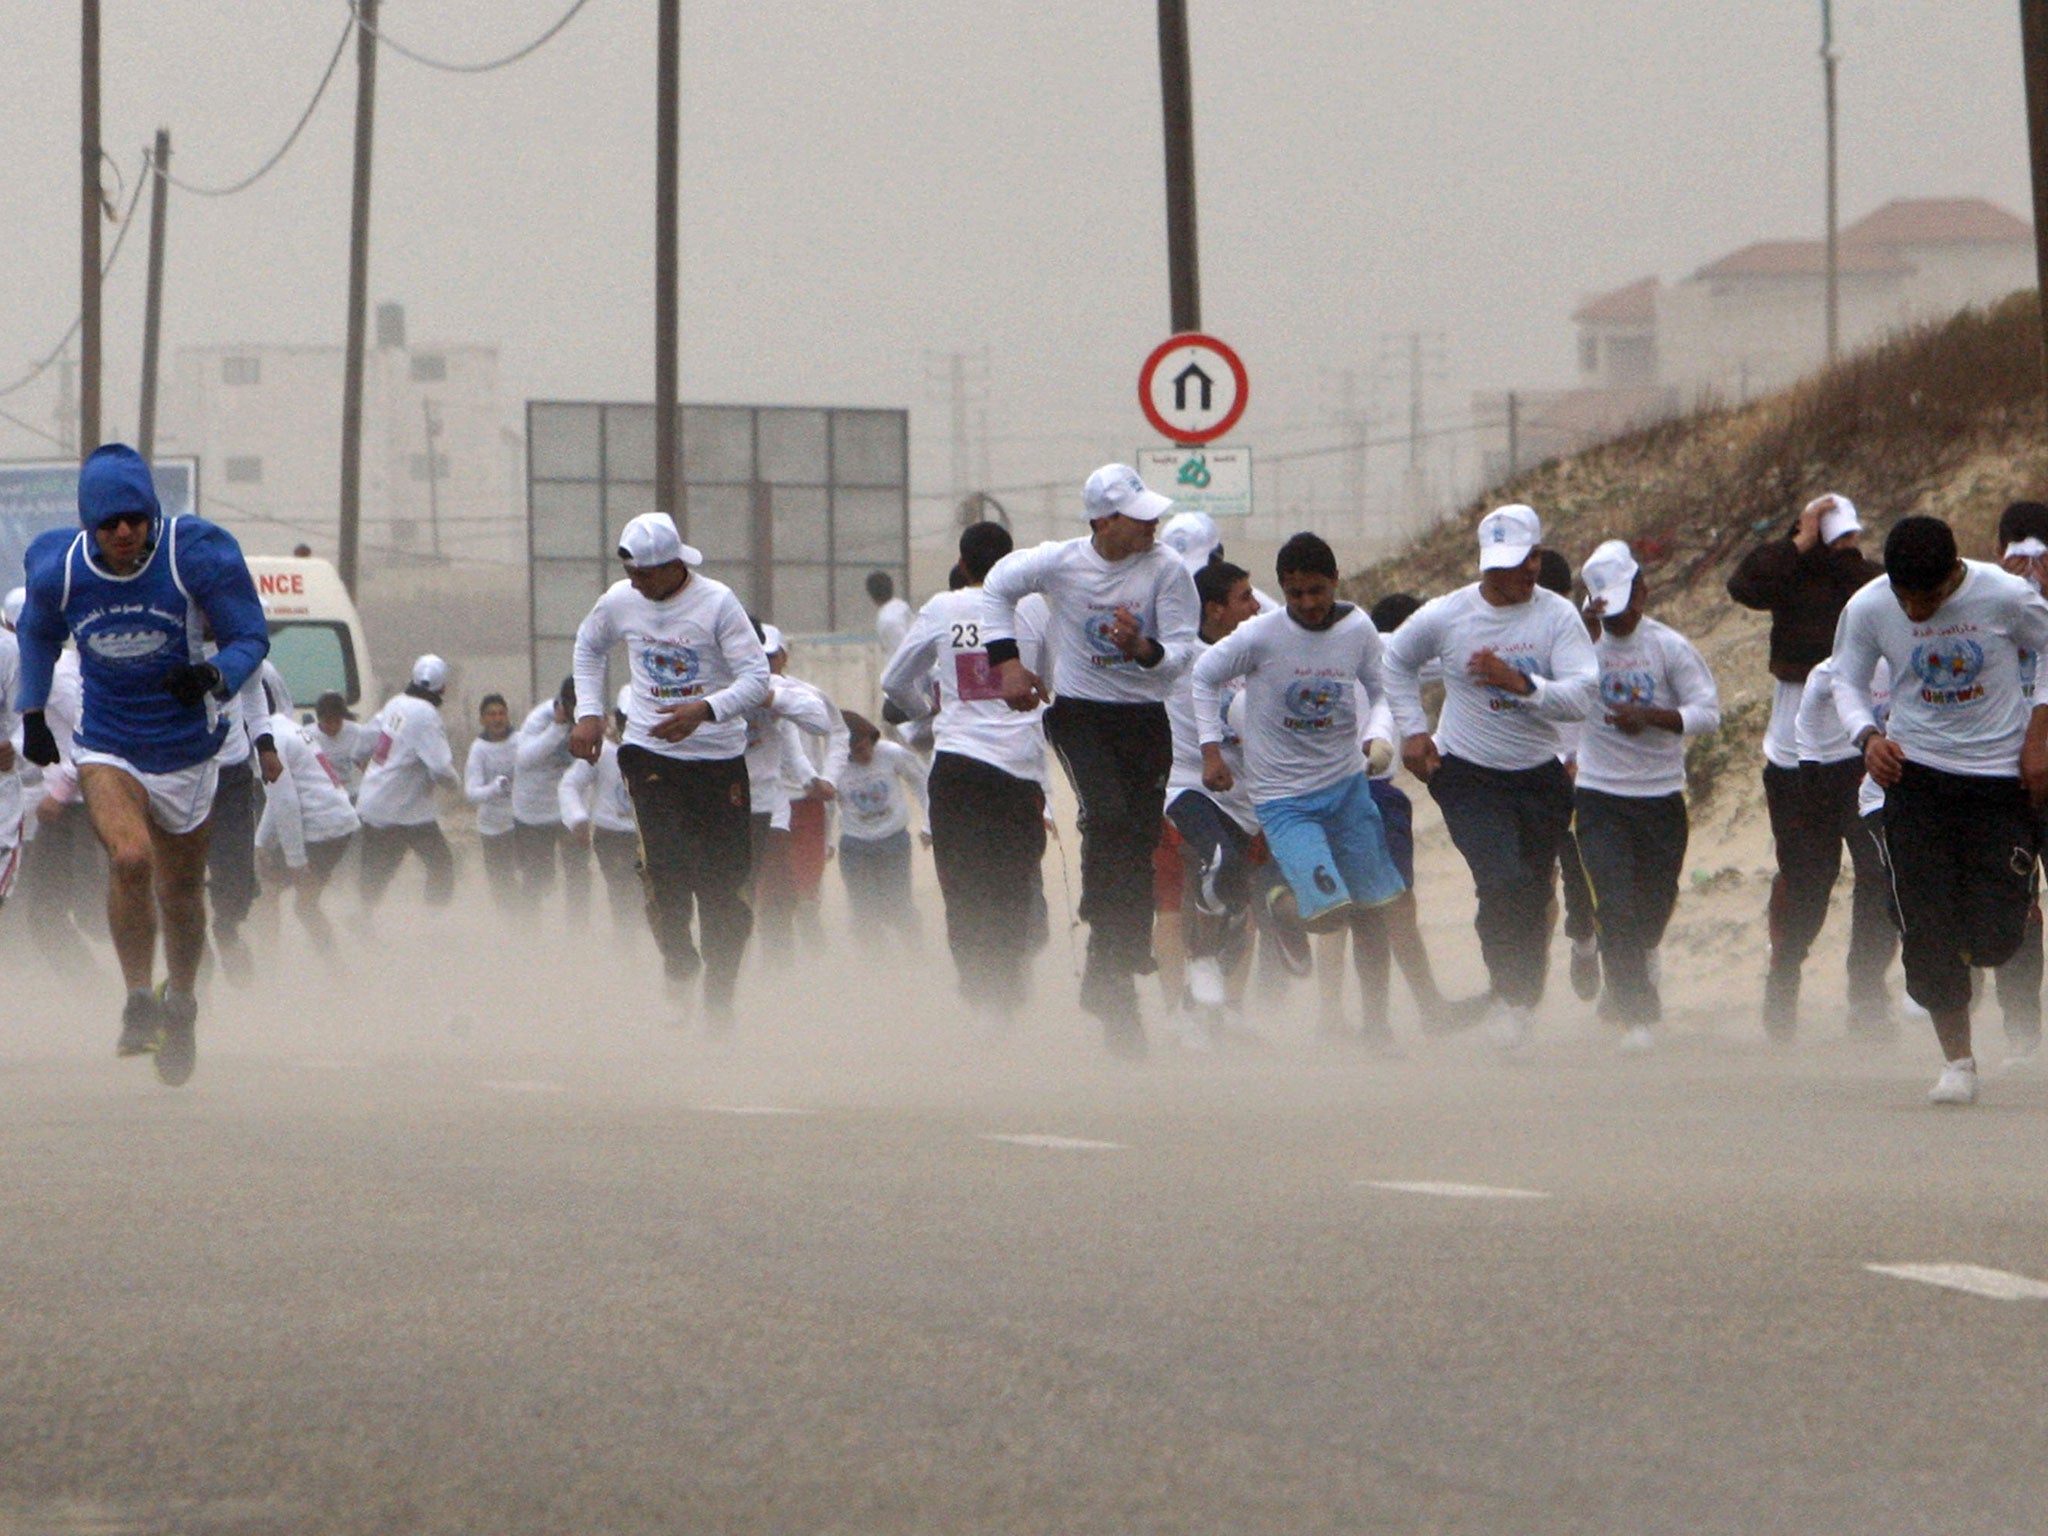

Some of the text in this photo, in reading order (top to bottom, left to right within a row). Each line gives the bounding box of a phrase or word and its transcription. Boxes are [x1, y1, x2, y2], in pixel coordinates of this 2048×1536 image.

[256, 574, 304, 594] NCE
[951, 624, 979, 647] 23
[1921, 683, 1985, 704] UNRWA
